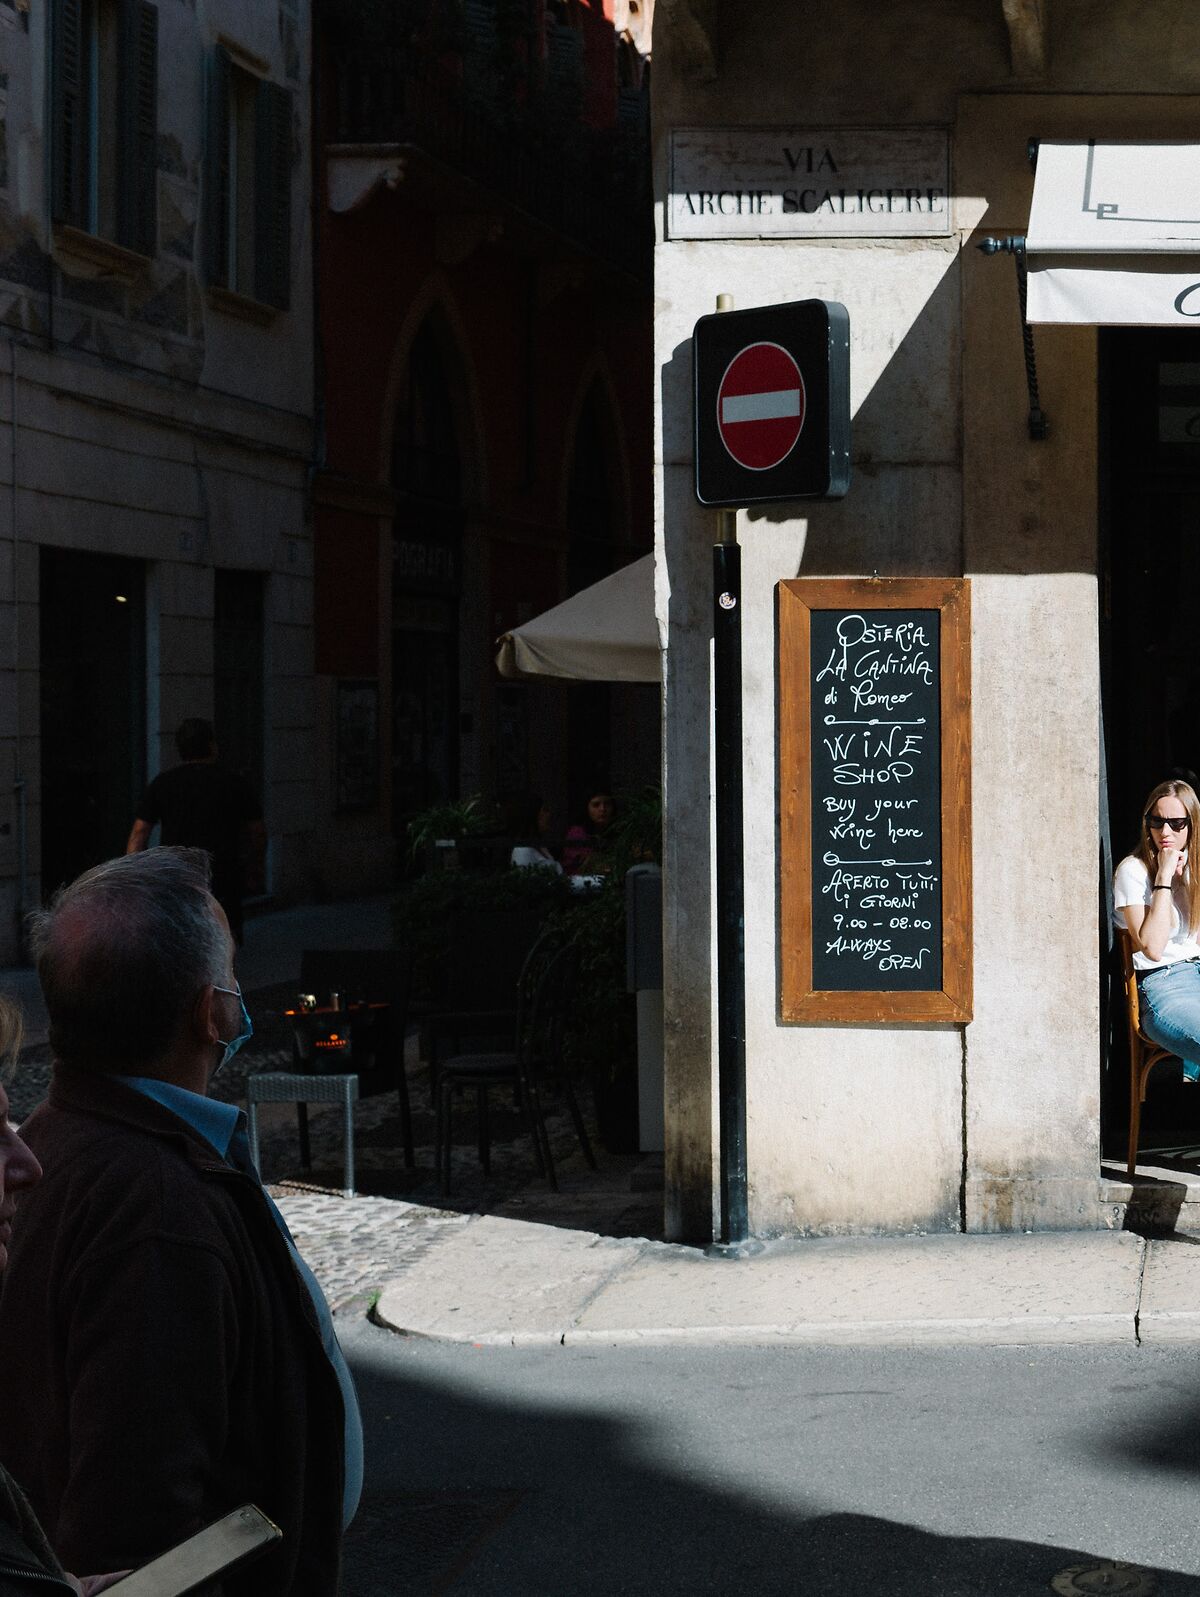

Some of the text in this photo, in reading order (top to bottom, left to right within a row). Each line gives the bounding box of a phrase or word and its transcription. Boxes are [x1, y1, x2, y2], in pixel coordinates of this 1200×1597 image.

[783, 148, 840, 173] VIA
[681, 187, 945, 215] ARCHE SCALIGERE
[816, 649, 933, 685] LA CANTINA
[825, 679, 913, 712] di Romeo
[824, 726, 924, 761] WINE
[833, 761, 914, 785] SHOP
[865, 799, 918, 822] your
[888, 818, 923, 843] here
[822, 869, 890, 902] APERTO
[833, 914, 867, 931] 9.00
[826, 936, 892, 960] ALWAYS
[879, 948, 931, 971] OPEN
